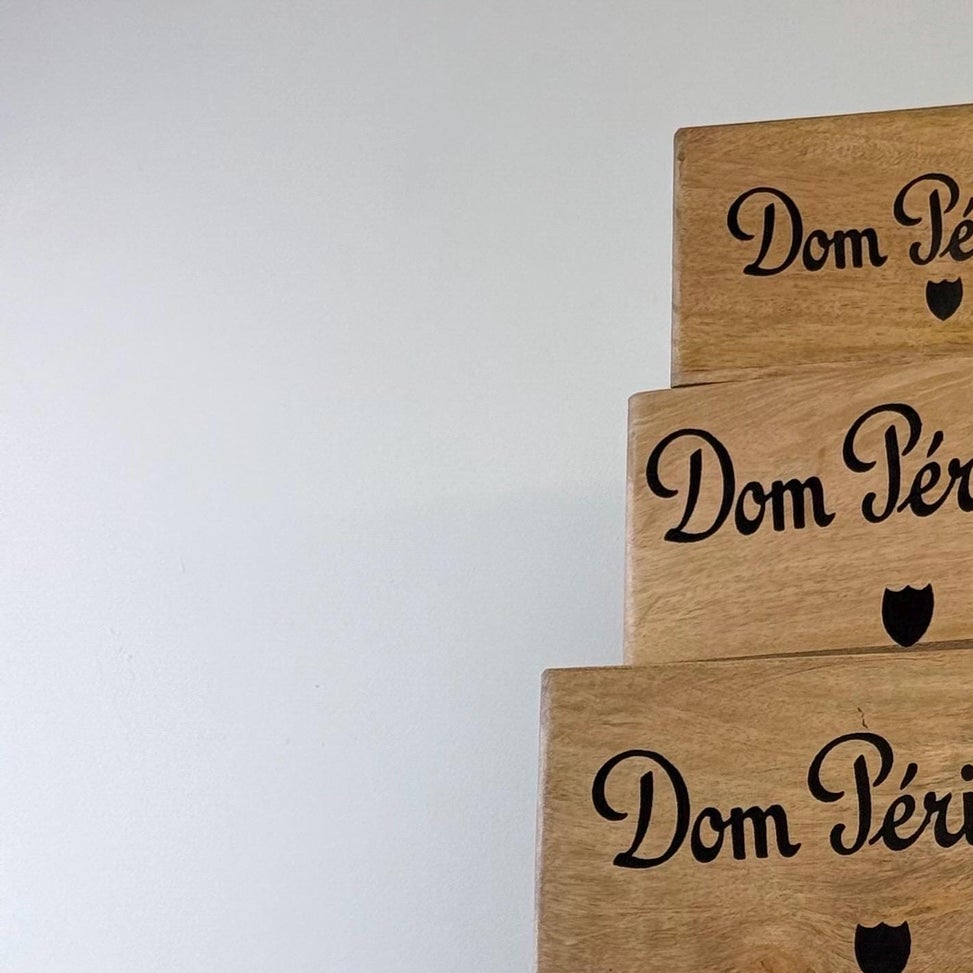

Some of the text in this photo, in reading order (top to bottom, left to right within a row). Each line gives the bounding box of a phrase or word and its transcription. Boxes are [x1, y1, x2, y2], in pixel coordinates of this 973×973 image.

[726, 186, 889, 277] Dom
[645, 428, 836, 544] Dom
[591, 749, 802, 869] Dom
